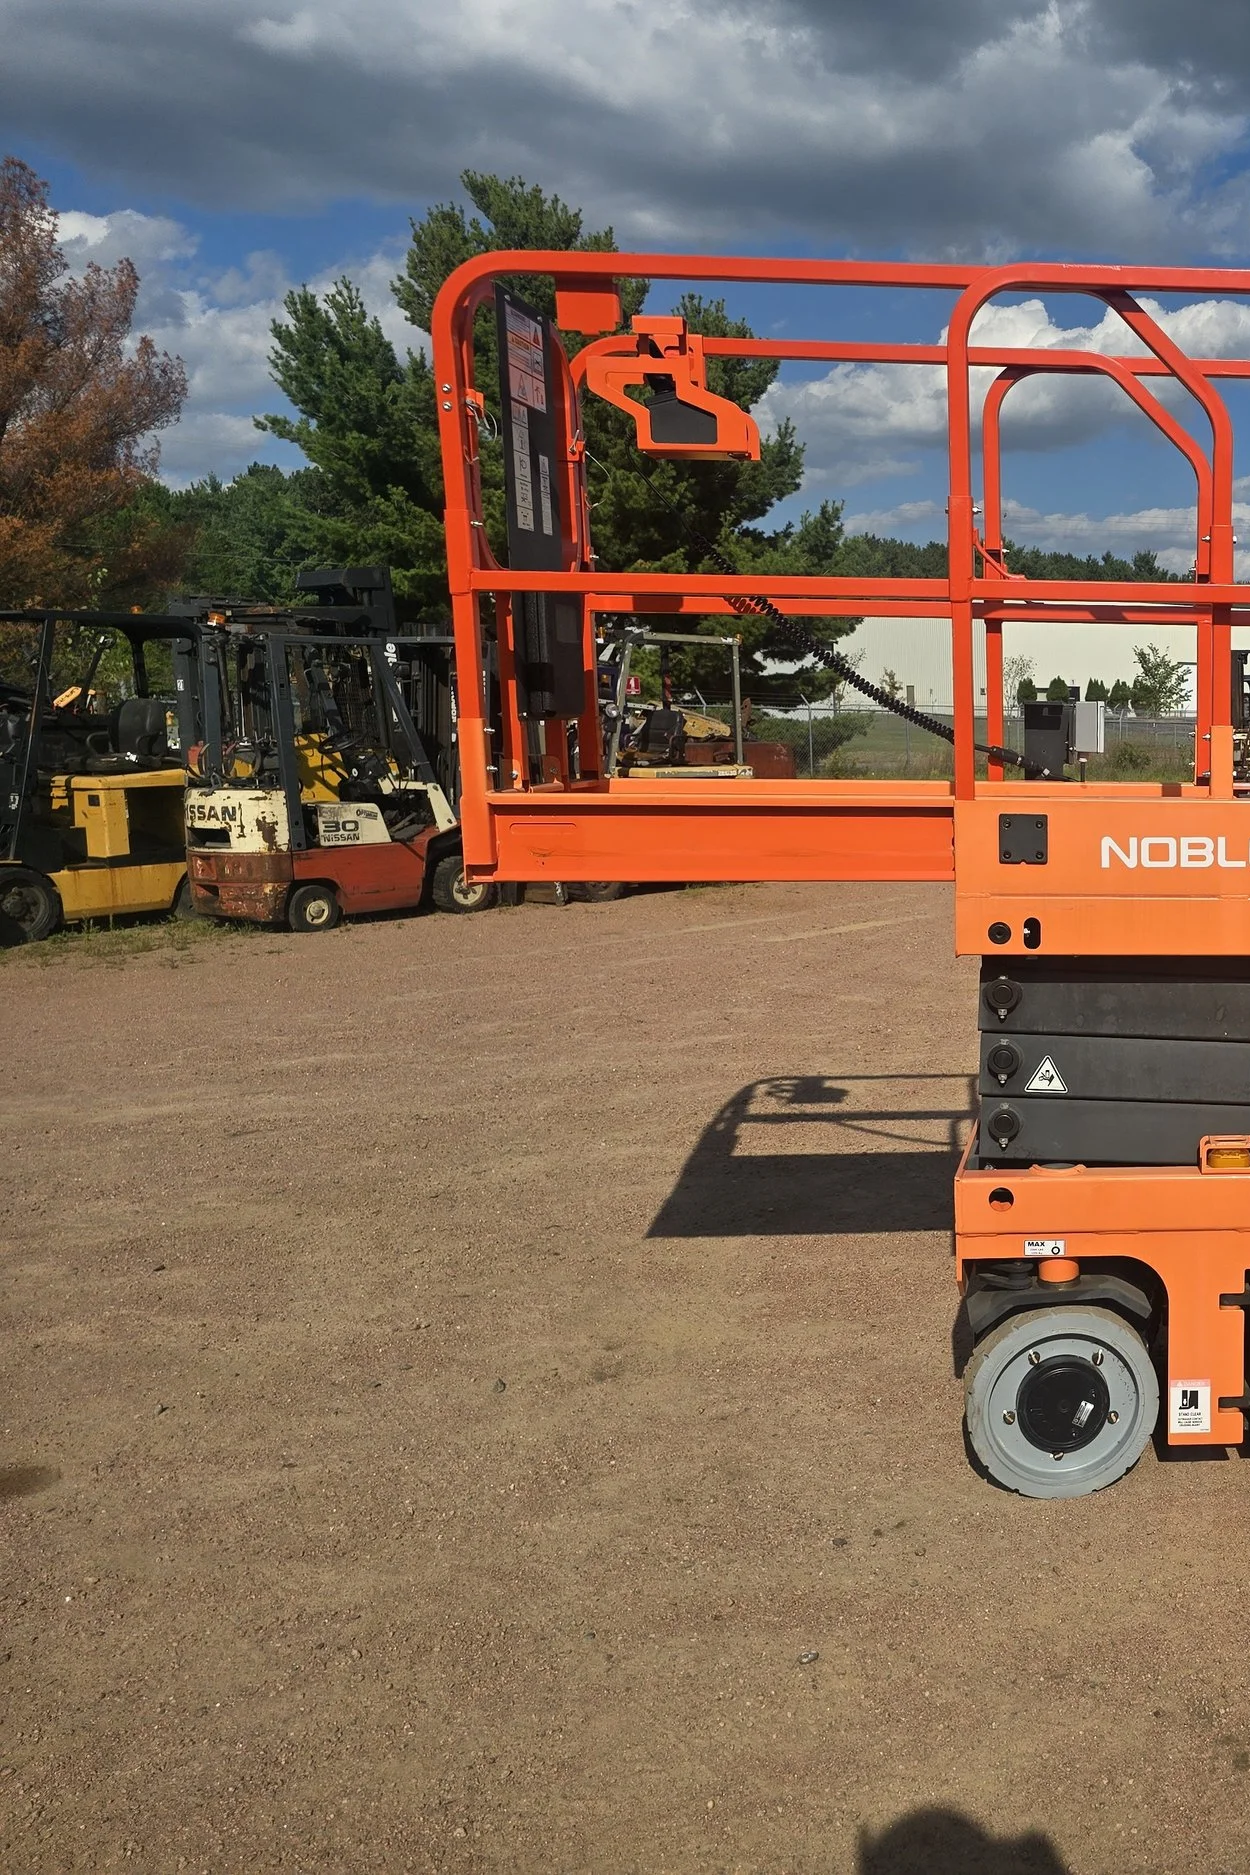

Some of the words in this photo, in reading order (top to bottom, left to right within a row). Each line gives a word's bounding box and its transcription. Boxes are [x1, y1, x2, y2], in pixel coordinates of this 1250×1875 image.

[185, 804, 237, 822] ISSAN
[322, 820, 359, 833] 30
[322, 833, 360, 843] NISSAN
